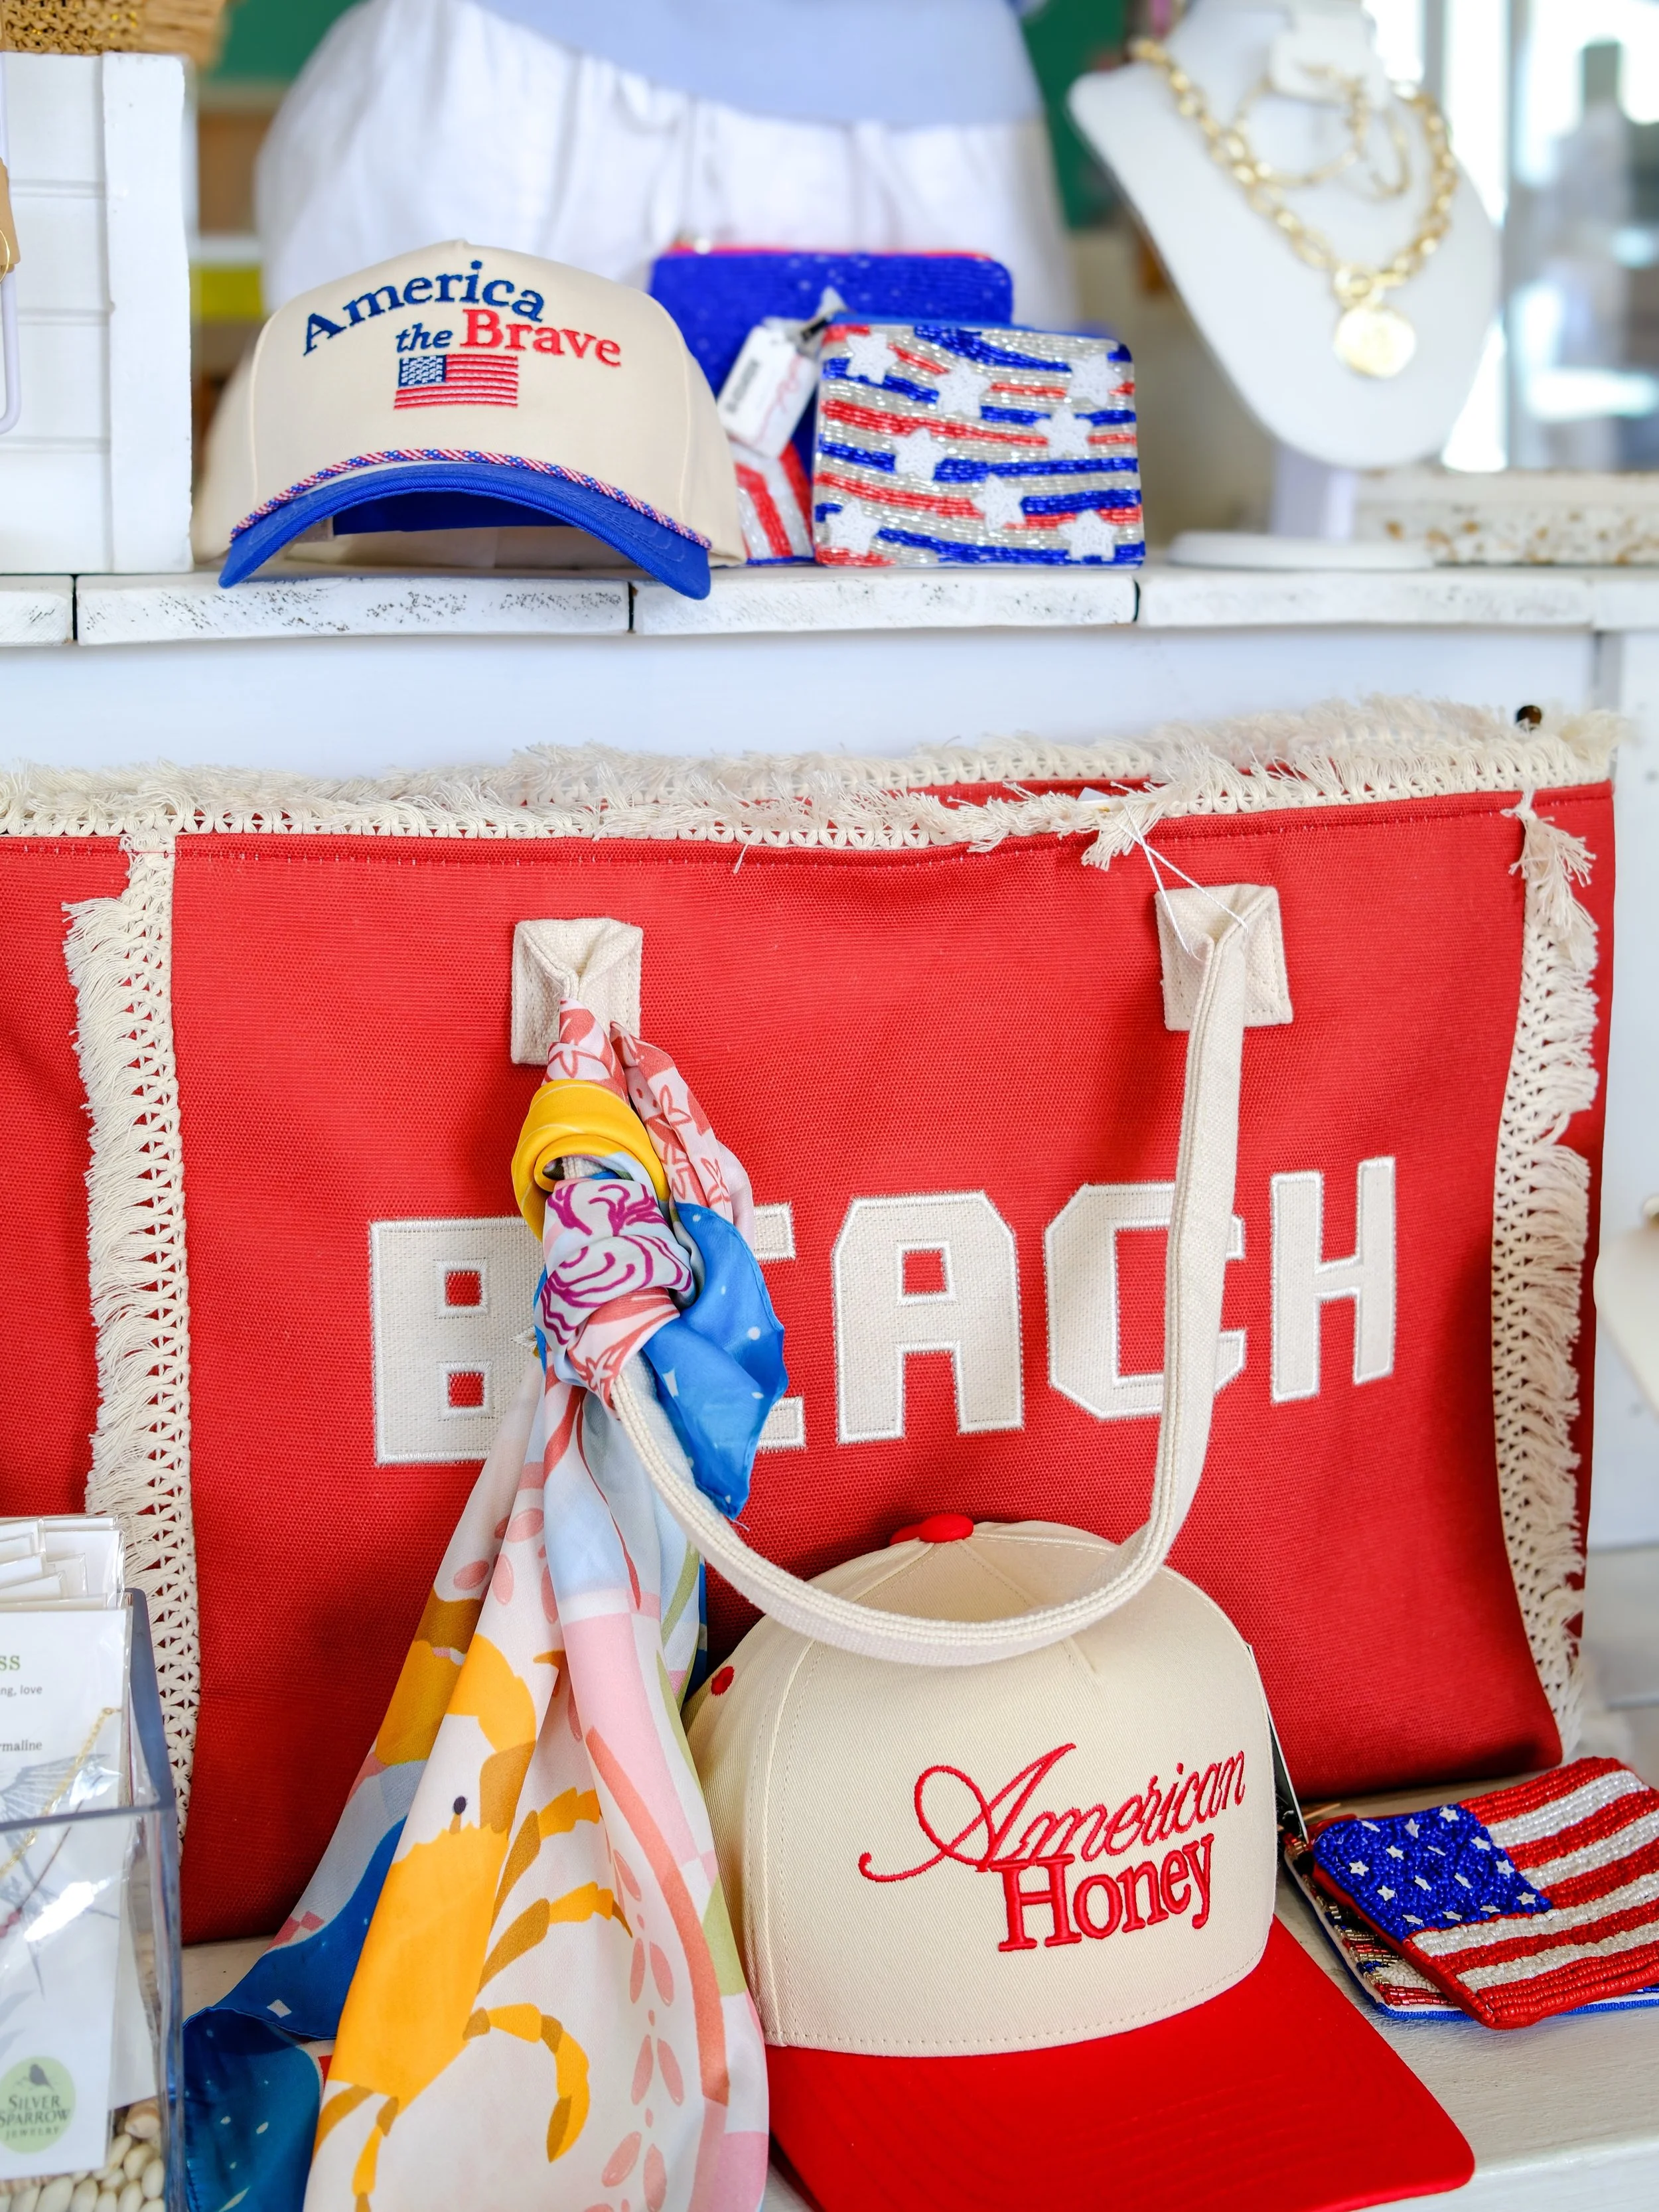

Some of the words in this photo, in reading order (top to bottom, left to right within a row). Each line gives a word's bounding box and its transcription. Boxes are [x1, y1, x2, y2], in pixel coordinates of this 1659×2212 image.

[303, 259, 545, 356] America
[396, 323, 454, 353] the
[459, 308, 621, 368] Brave
[20, 1684, 42, 1694] love
[859, 1742, 1246, 1882] American
[990, 1833, 1214, 1952] Honey
[9, 2095, 60, 2110] SILVER
